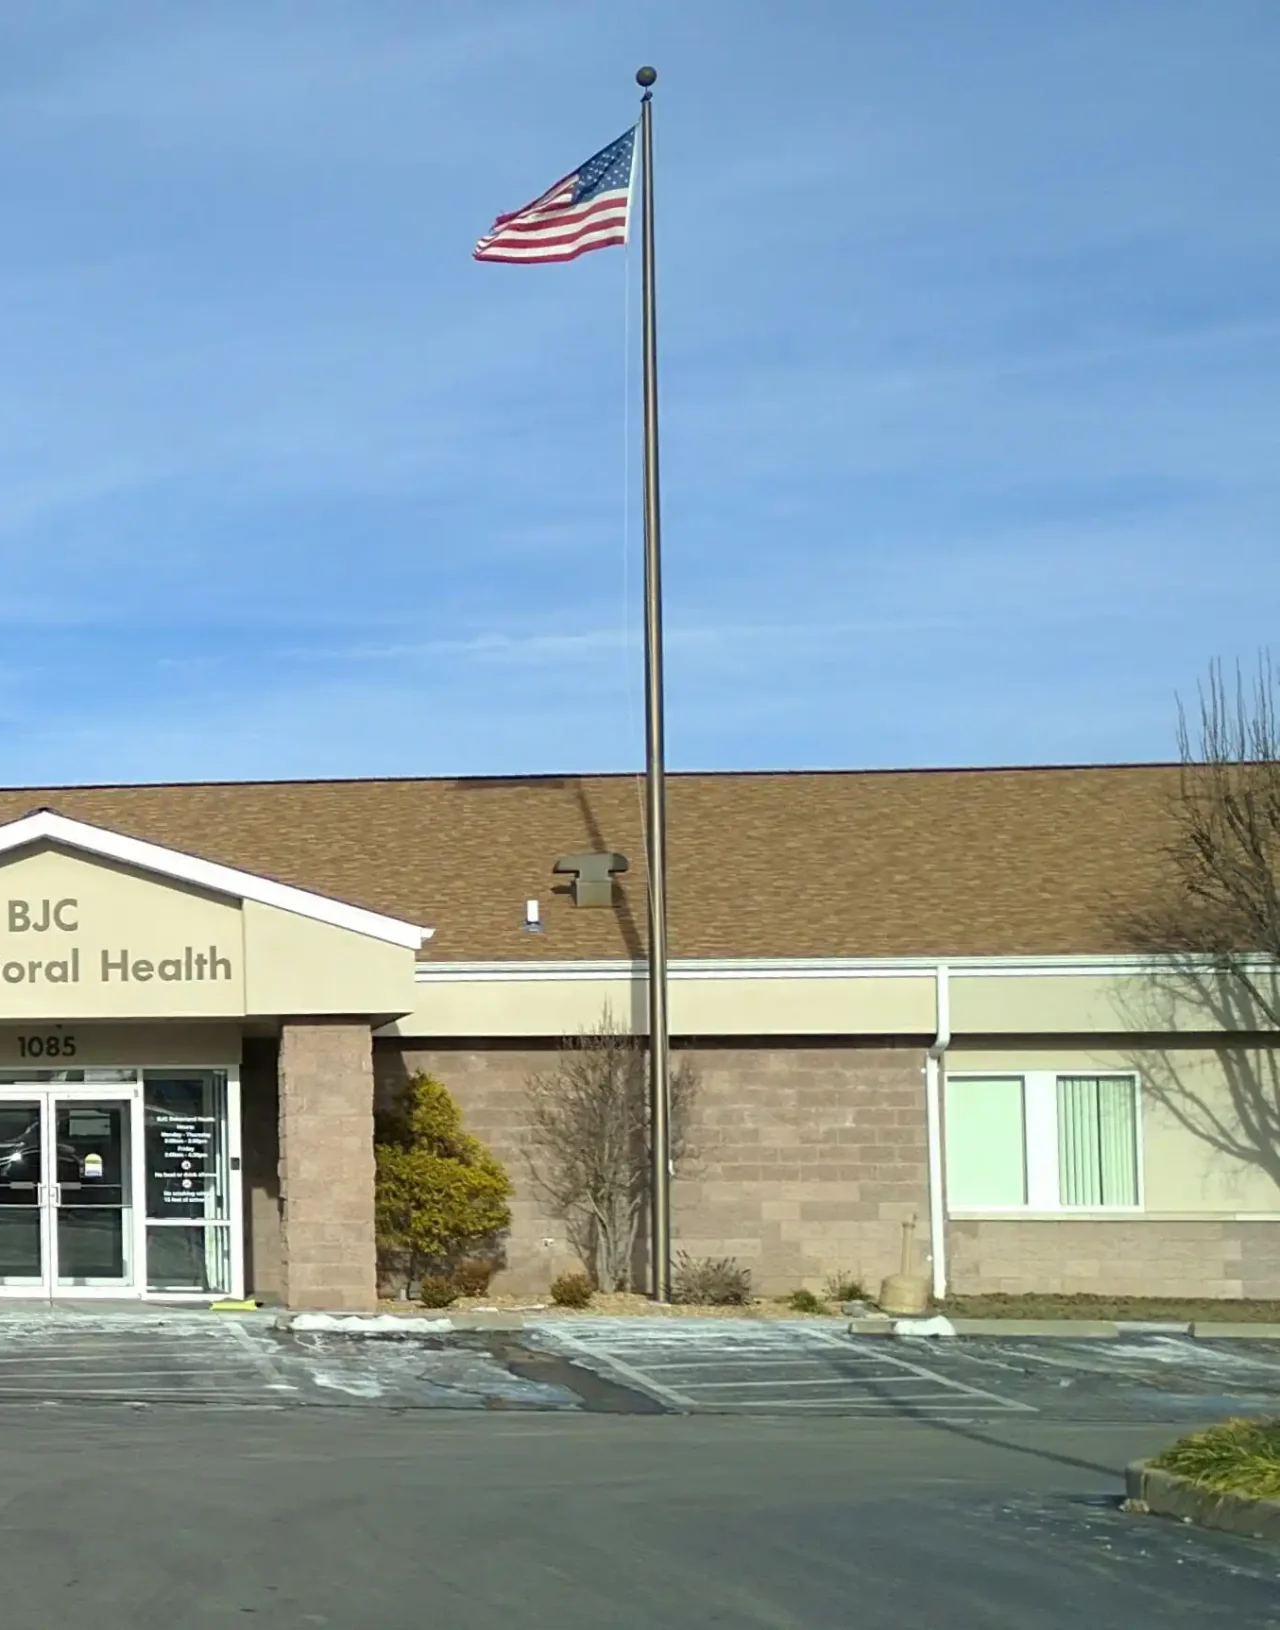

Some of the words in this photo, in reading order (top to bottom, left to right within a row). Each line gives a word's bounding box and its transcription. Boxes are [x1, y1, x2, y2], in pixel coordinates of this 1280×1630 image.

[8, 899, 79, 932] BJC
[101, 946, 232, 982] Health
[17, 1035, 77, 1058] 1085
[186, 1131, 211, 1139] Thursday
[177, 1145, 195, 1153] Friday
